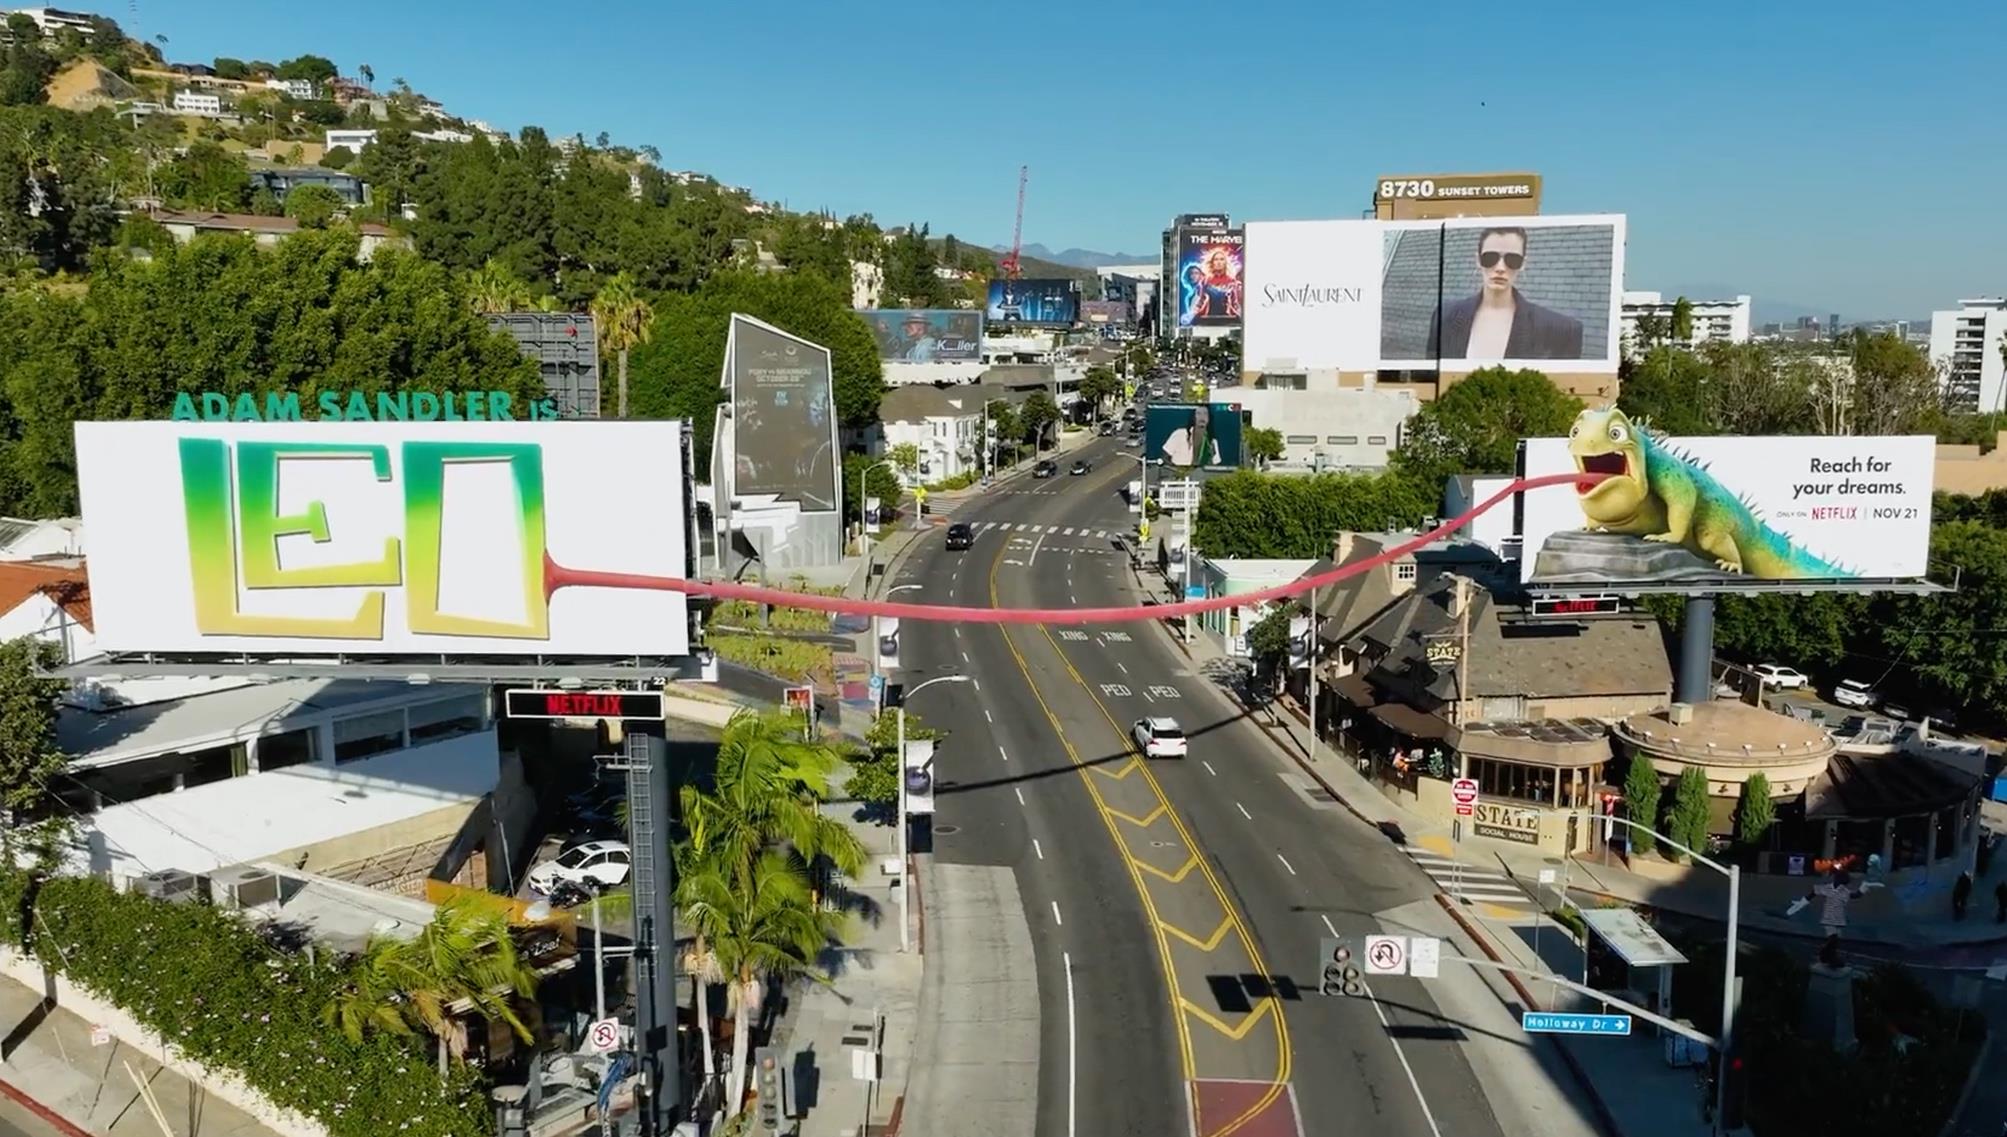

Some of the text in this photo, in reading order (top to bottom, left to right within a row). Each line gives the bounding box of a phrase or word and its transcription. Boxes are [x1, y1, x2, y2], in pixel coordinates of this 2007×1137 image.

[1381, 181, 1530, 198] 8730 SUNSET TOWERS
[1191, 235, 1243, 243] THE MARVE
[172, 391, 560, 422] ADAM SANDLER IS
[1810, 456, 1892, 473] Reach for
[1792, 477, 1906, 500] your dreams.
[1811, 506, 1857, 519] NETFLIX
[1873, 507, 1900, 519] NOV
[1904, 507, 1918, 519] 21
[178, 437, 549, 640] LEO
[1059, 630, 1089, 641] XING
[1101, 631, 1132, 642] XING
[1426, 646, 1461, 657] STATE
[653, 677, 666, 685] 22
[1100, 683, 1132, 697] PED
[1149, 685, 1181, 698] PED
[546, 694, 622, 715] NETFLIX
[1476, 804, 1538, 830] STATE
[1480, 827, 1535, 842] SOCIAL HOUSE
[1527, 1016, 1606, 1031] Holloway Dr
